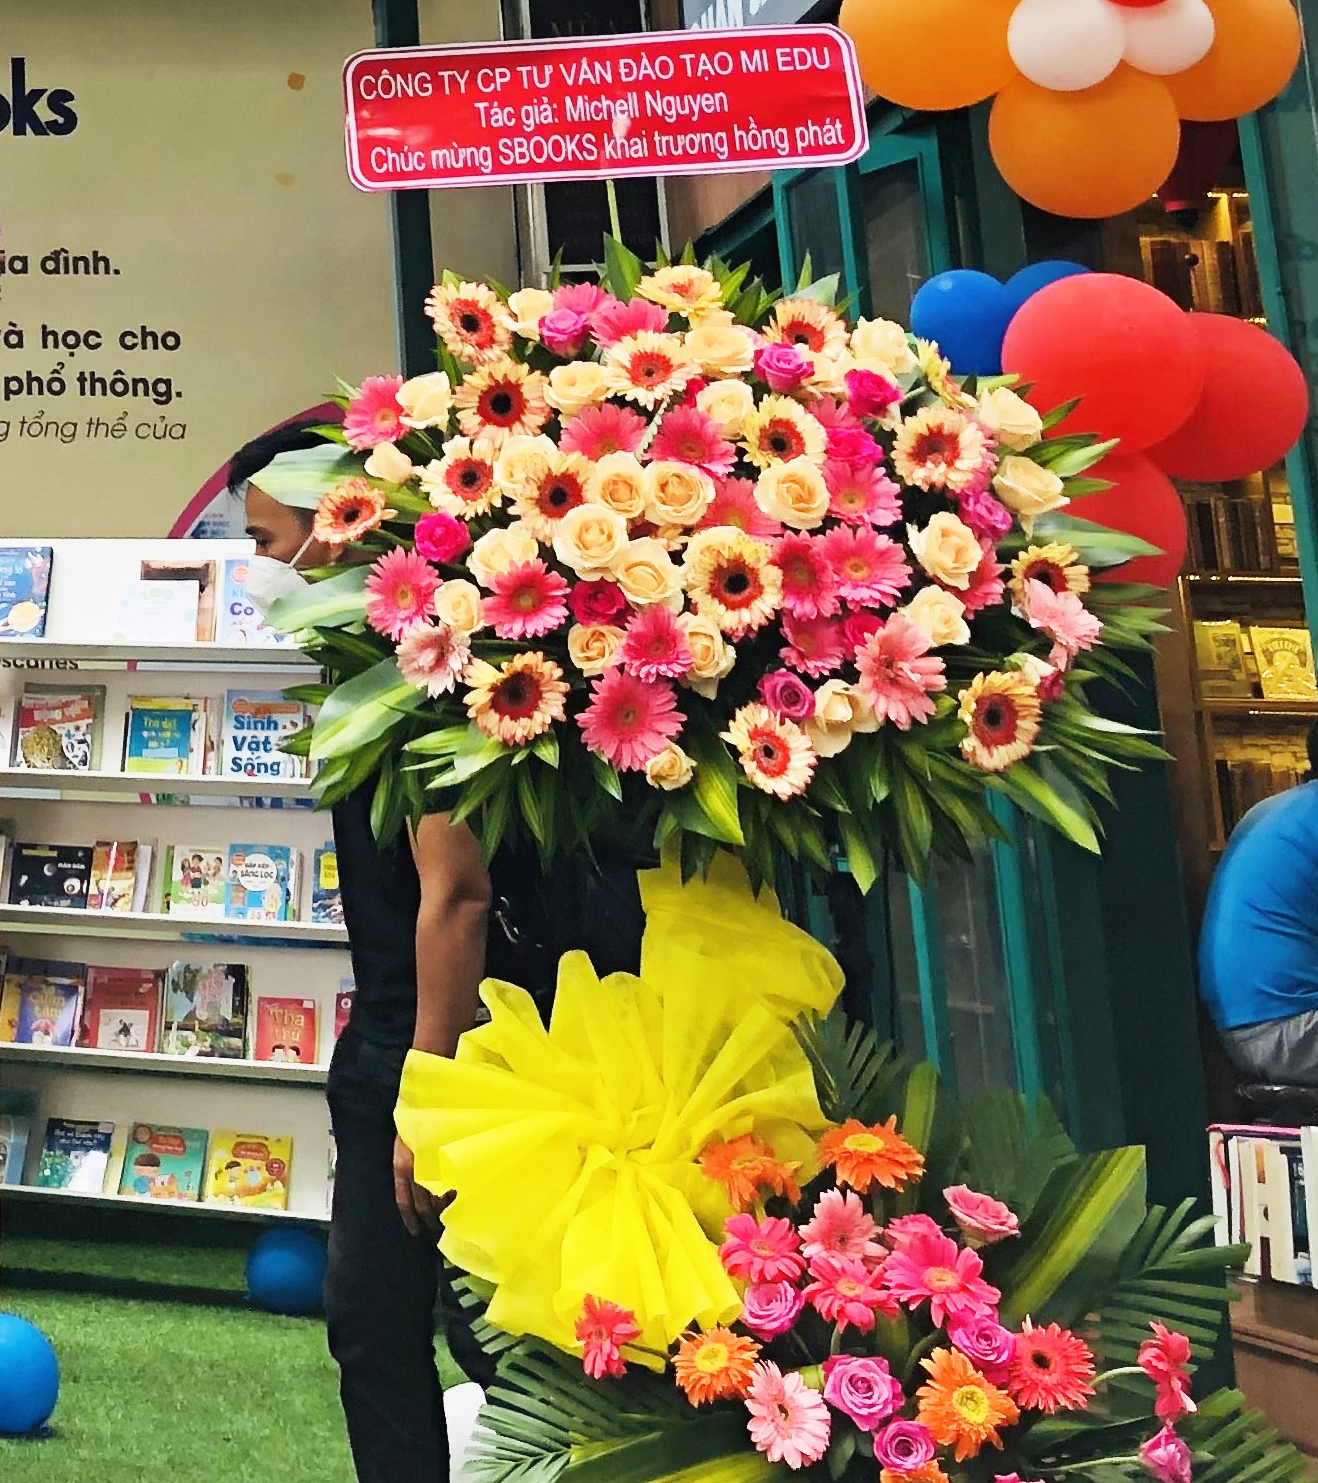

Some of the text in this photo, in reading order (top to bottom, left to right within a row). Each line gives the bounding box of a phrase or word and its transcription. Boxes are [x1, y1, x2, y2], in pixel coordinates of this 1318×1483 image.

[360, 46, 831, 100] CÔNG TY CP TƯ VẤN ĐÀO TẠO MI EDU
[473, 90, 728, 134] Tác giả: Michell Nguyen
[370, 115, 845, 176] Chúc mừng SBOOKS khai trương hồng phát
[41, 248, 121, 276] đình.
[41, 324, 102, 357] học
[119, 325, 181, 351] cho
[4, 362, 66, 400] phổ
[77, 371, 182, 405] thông.
[19, 410, 78, 443] tổng
[87, 412, 128, 439] thể
[135, 414, 187, 440] của
[233, 714, 279, 731] Sinh
[232, 736, 273, 756] Vật
[230, 755, 280, 776] Sống
[269, 1008, 304, 1027] Tha
